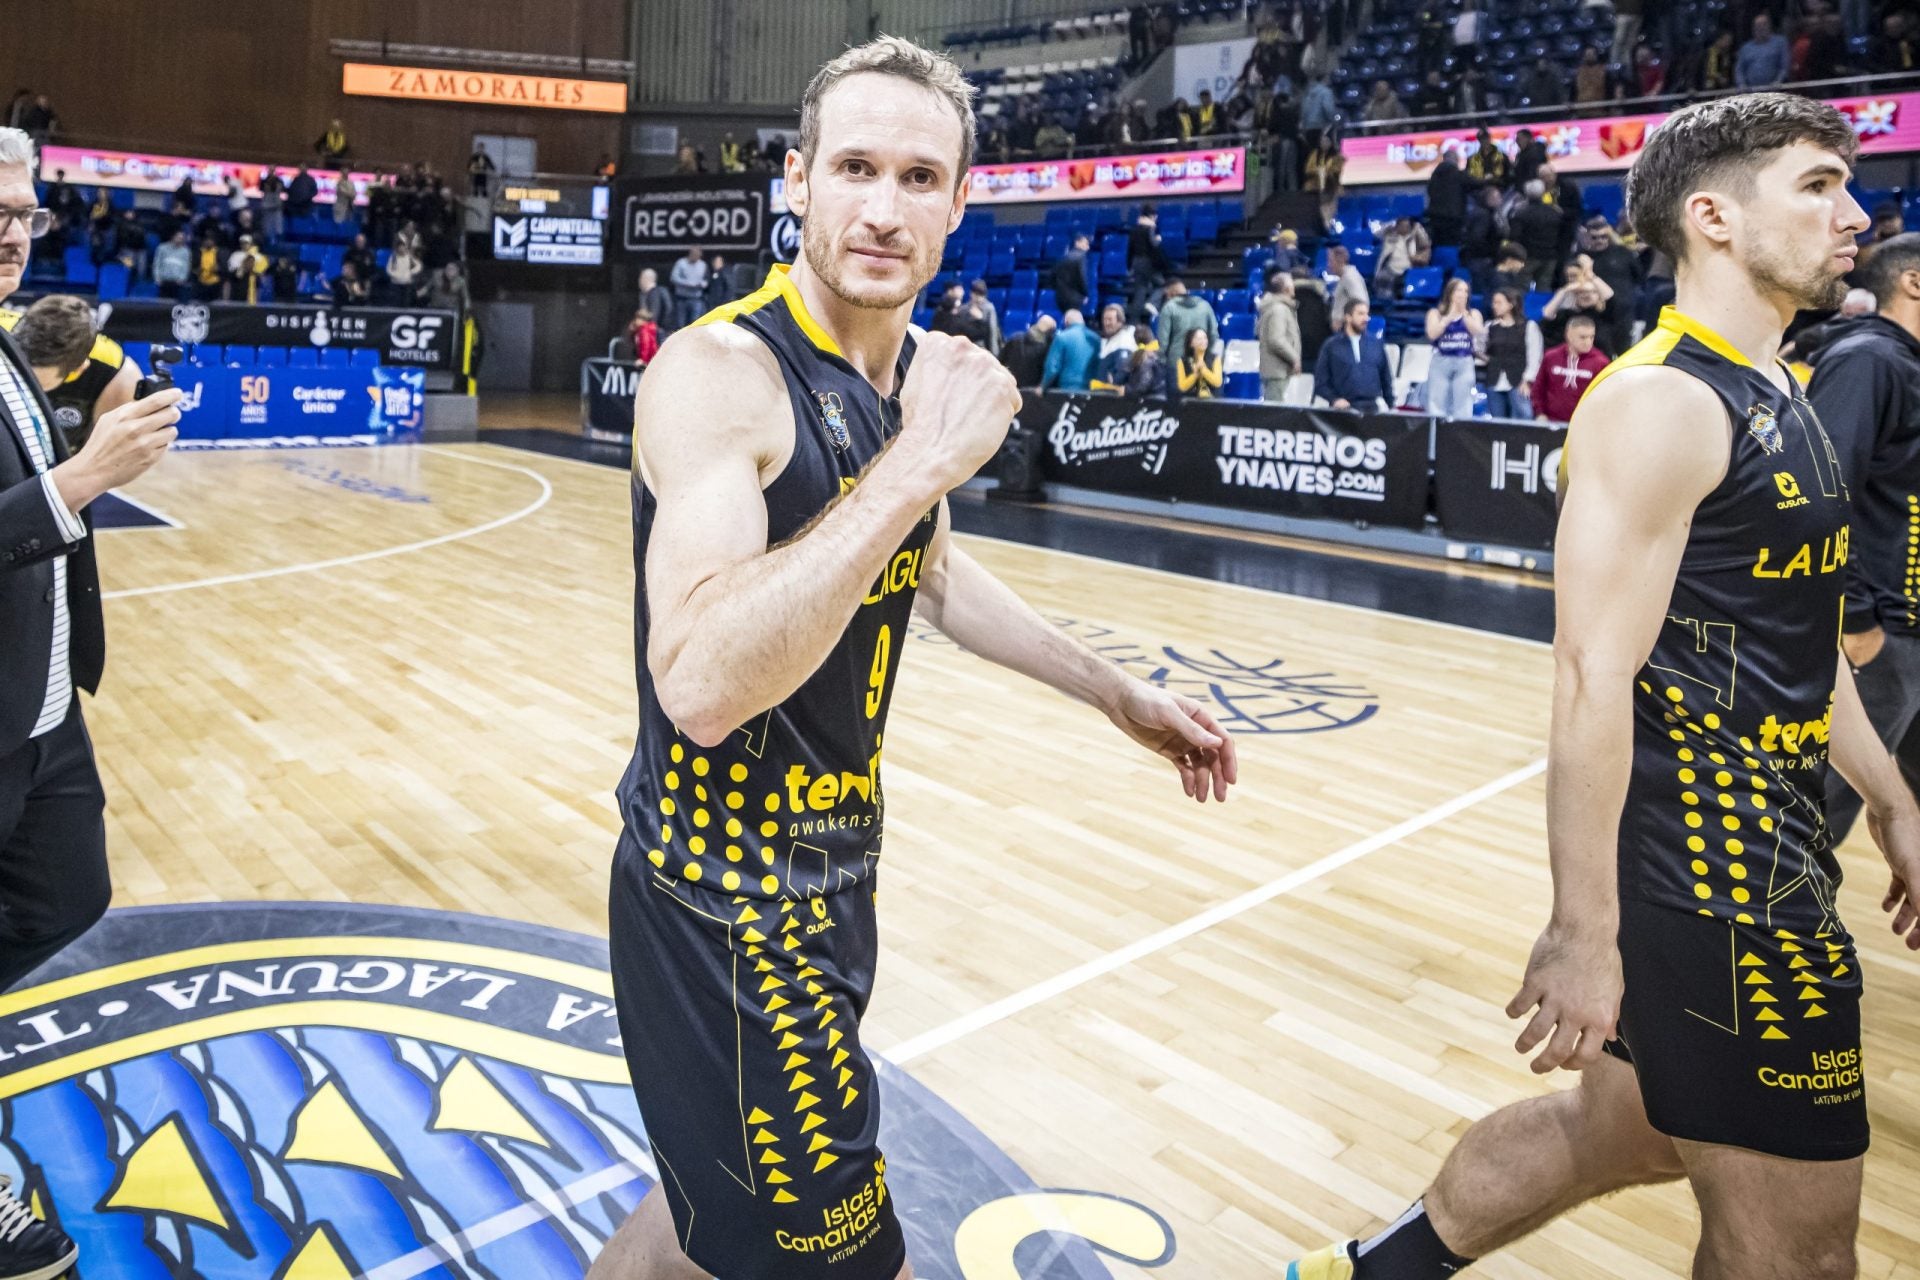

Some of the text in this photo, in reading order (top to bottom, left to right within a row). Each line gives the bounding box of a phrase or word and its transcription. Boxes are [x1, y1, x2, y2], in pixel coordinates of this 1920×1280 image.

[388, 69, 585, 105] ZAMORALES
[1095, 157, 1212, 183] Islas Canarias
[633, 207, 751, 238] RECORD
[390, 315, 442, 349] GF
[389, 349, 441, 362] HOTELES
[240, 375, 270, 403] 50
[1217, 424, 1387, 471] TERRENOS
[1752, 543, 1812, 579] LA
[865, 624, 891, 720] 9
[788, 813, 873, 838] awakens
[146, 960, 517, 1012] LAGUNA
[1812, 1048, 1858, 1071] Islas
[1758, 1066, 1860, 1090] Canarias
[822, 1182, 874, 1228] Islas
[775, 1201, 877, 1253] Canarias
